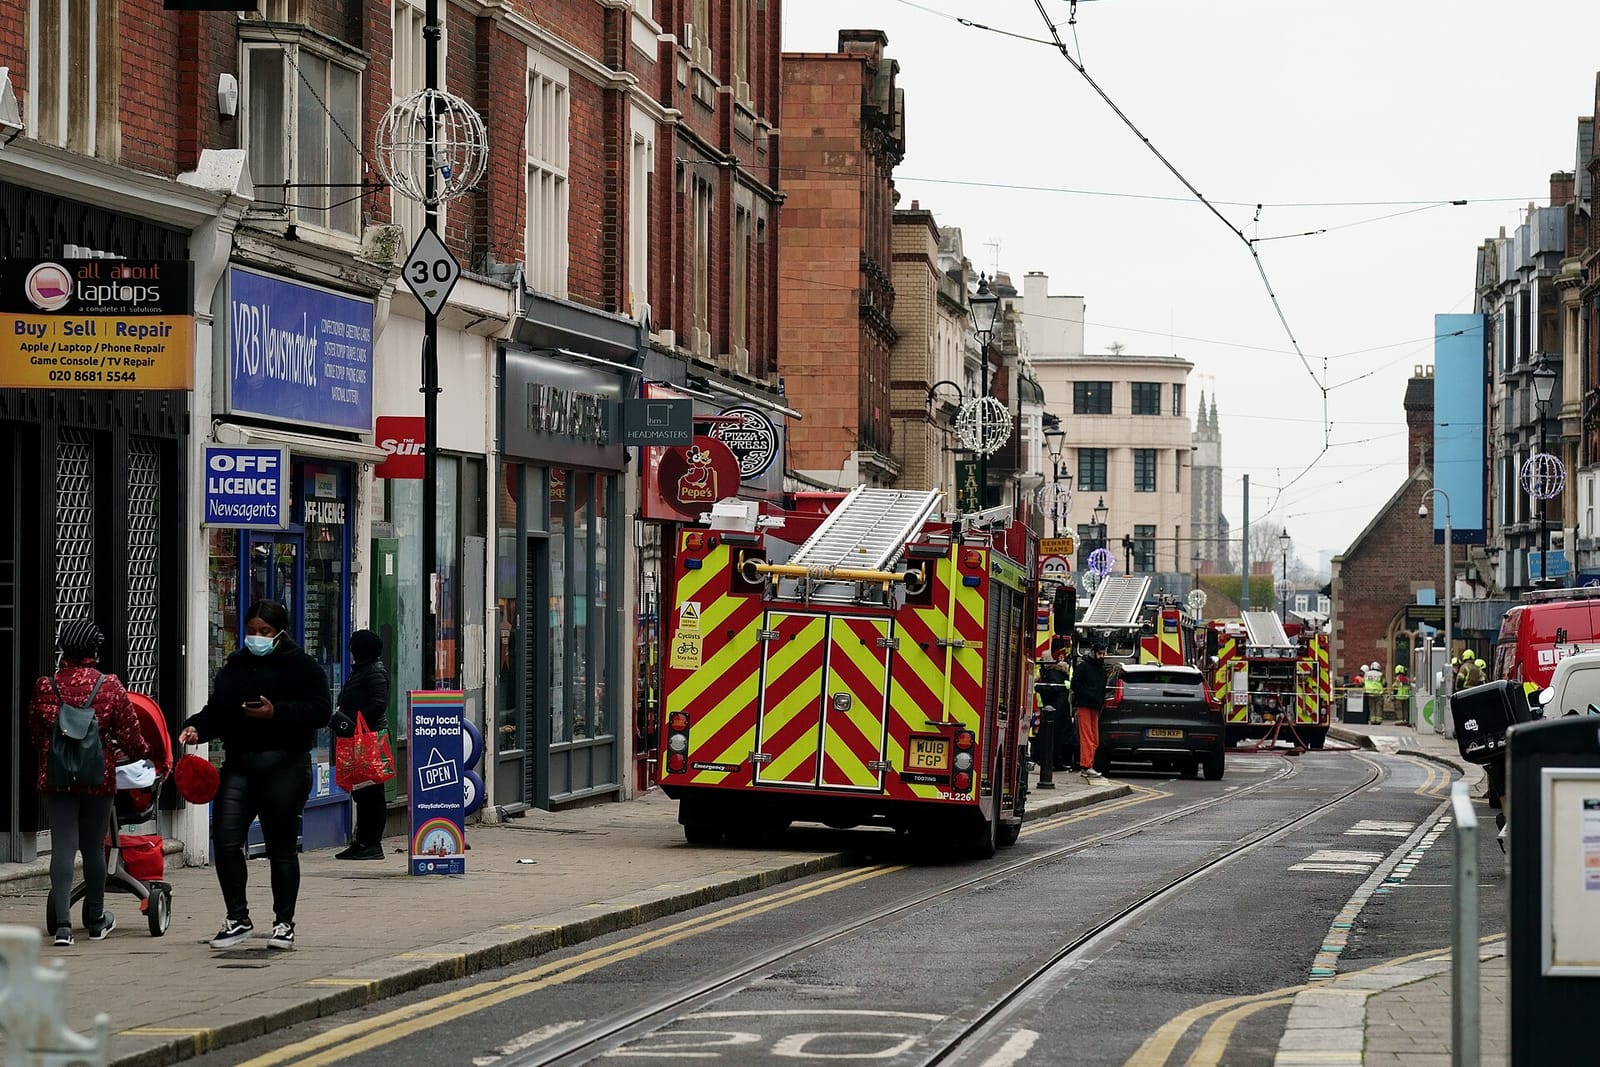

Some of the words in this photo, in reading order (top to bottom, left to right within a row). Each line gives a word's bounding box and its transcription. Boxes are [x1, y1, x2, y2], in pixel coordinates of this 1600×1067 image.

[77, 262, 100, 280] all
[110, 263, 160, 280] about
[411, 259, 451, 283] 30
[77, 280, 160, 306] laptops
[86, 306, 118, 314] complete
[14, 320, 47, 338] Buy
[63, 320, 96, 336] Sell
[116, 321, 172, 340] Repair
[20, 342, 49, 353] Apple
[58, 343, 92, 353] Laptop
[101, 343, 132, 353] Phone
[134, 344, 165, 354] Repair
[232, 301, 260, 380] YRB
[262, 304, 317, 388] Newsmarket
[30, 356, 57, 365] Game
[60, 356, 98, 366] Console
[107, 357, 121, 366] TV
[123, 357, 155, 368] Repair
[49, 371, 71, 381] 020
[74, 371, 102, 382] 8681
[106, 371, 136, 382] 5544
[649, 416, 662, 425] hm
[627, 430, 689, 440] HEADMASTERS
[724, 432, 758, 441] PIZZA
[209, 455, 277, 473] OFF
[208, 477, 277, 495] LICENCE
[681, 486, 713, 499] Pepe's
[209, 499, 277, 521] Newsagents
[677, 632, 701, 640] Cyclists
[415, 715, 435, 726] Stay
[436, 715, 461, 726] local,
[415, 727, 437, 738] shop
[439, 726, 461, 736] local
[917, 741, 944, 754] WU18
[693, 762, 726, 771] Emergency
[917, 754, 942, 767] FGP
[425, 765, 451, 785] OPEN
[936, 791, 972, 802] DPL226
[417, 802, 460, 810] #StaySafeCroydon
